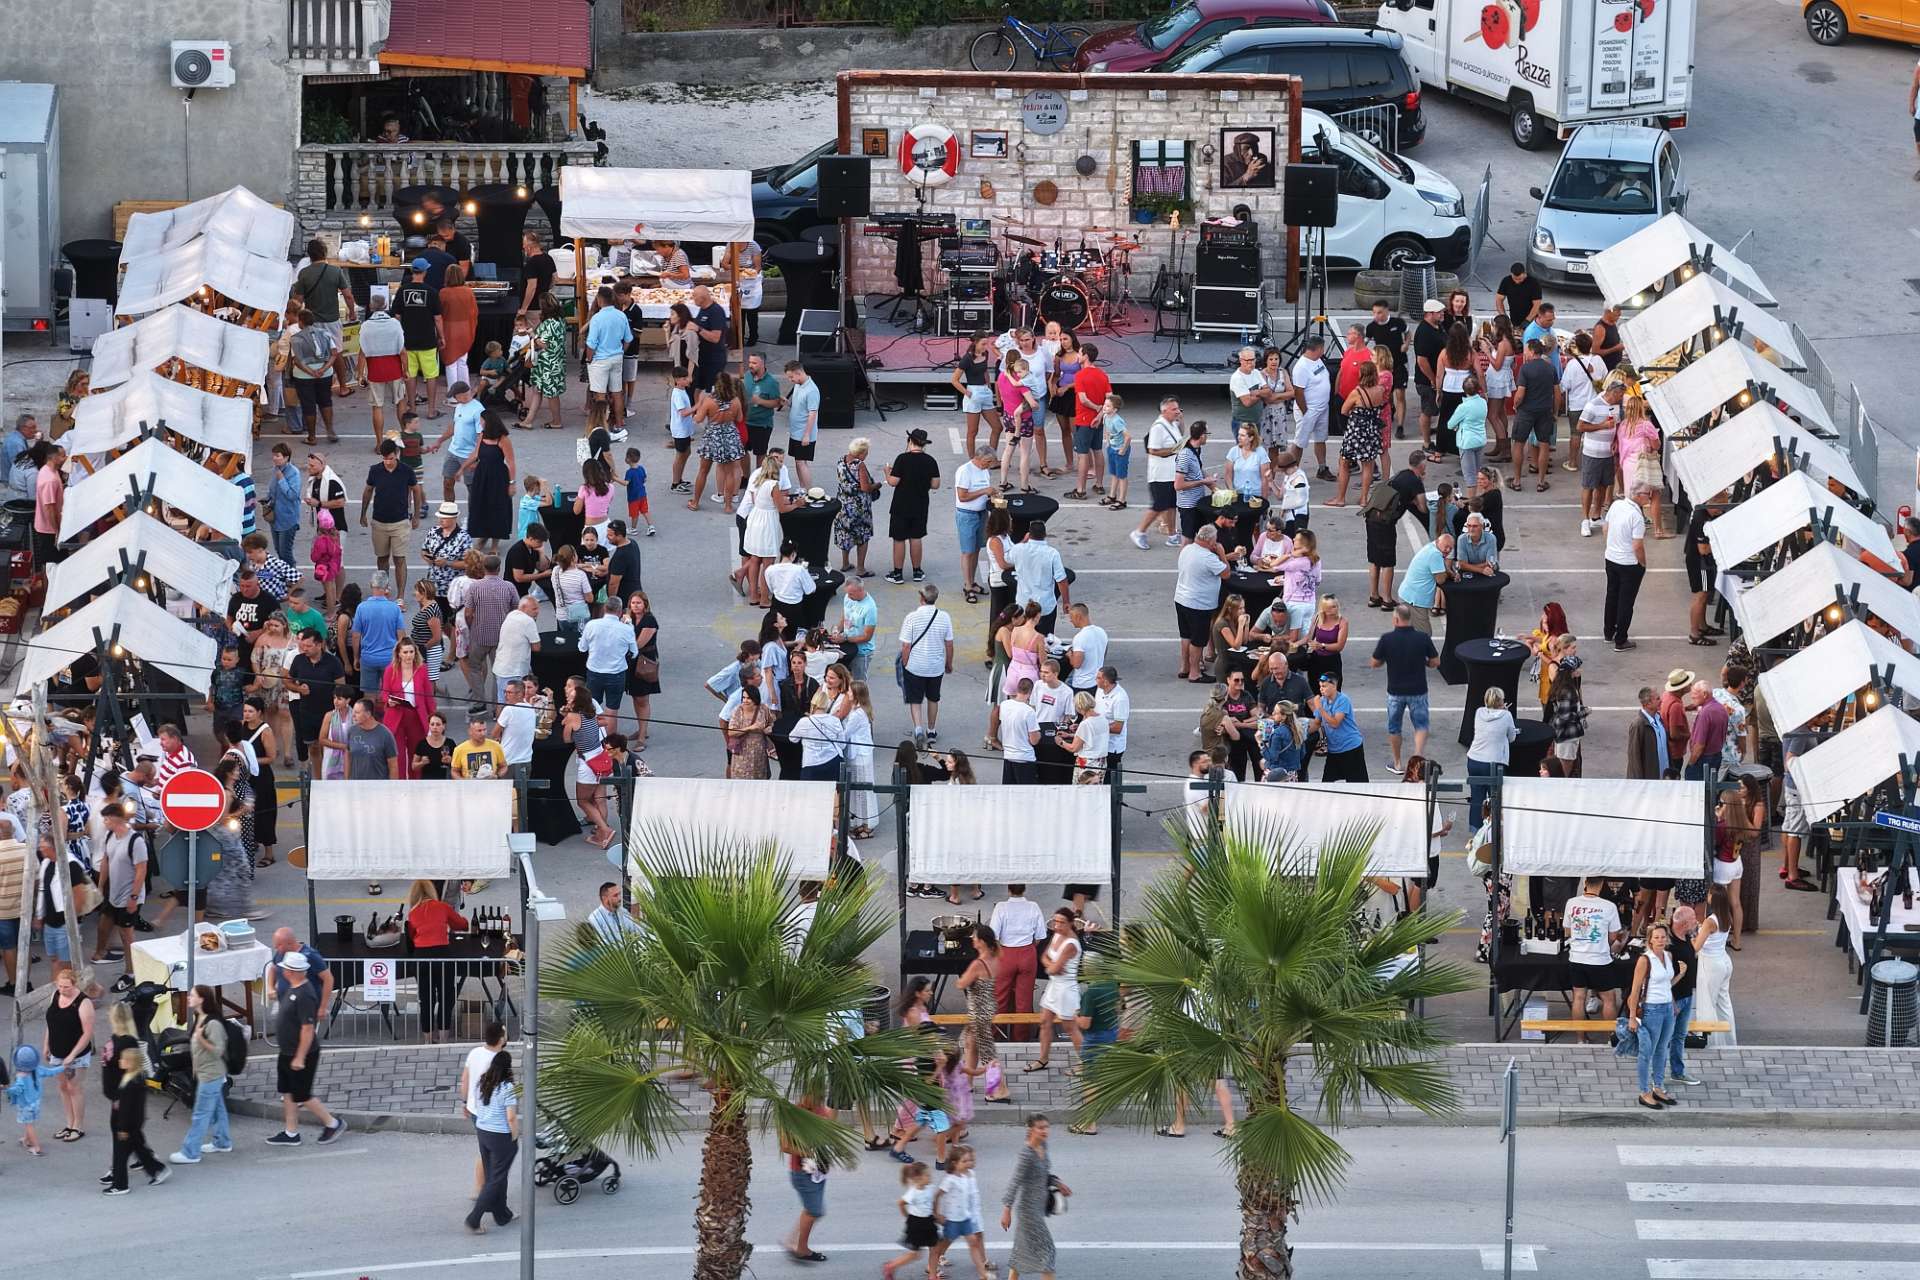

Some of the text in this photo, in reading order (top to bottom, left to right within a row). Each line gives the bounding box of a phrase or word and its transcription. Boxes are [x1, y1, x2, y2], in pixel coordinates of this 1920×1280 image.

[1515, 44, 1551, 89] Piazza
[240, 602, 258, 613] JUST
[235, 610, 248, 621] DO
[1887, 817, 1920, 831] TRG RUŠE
